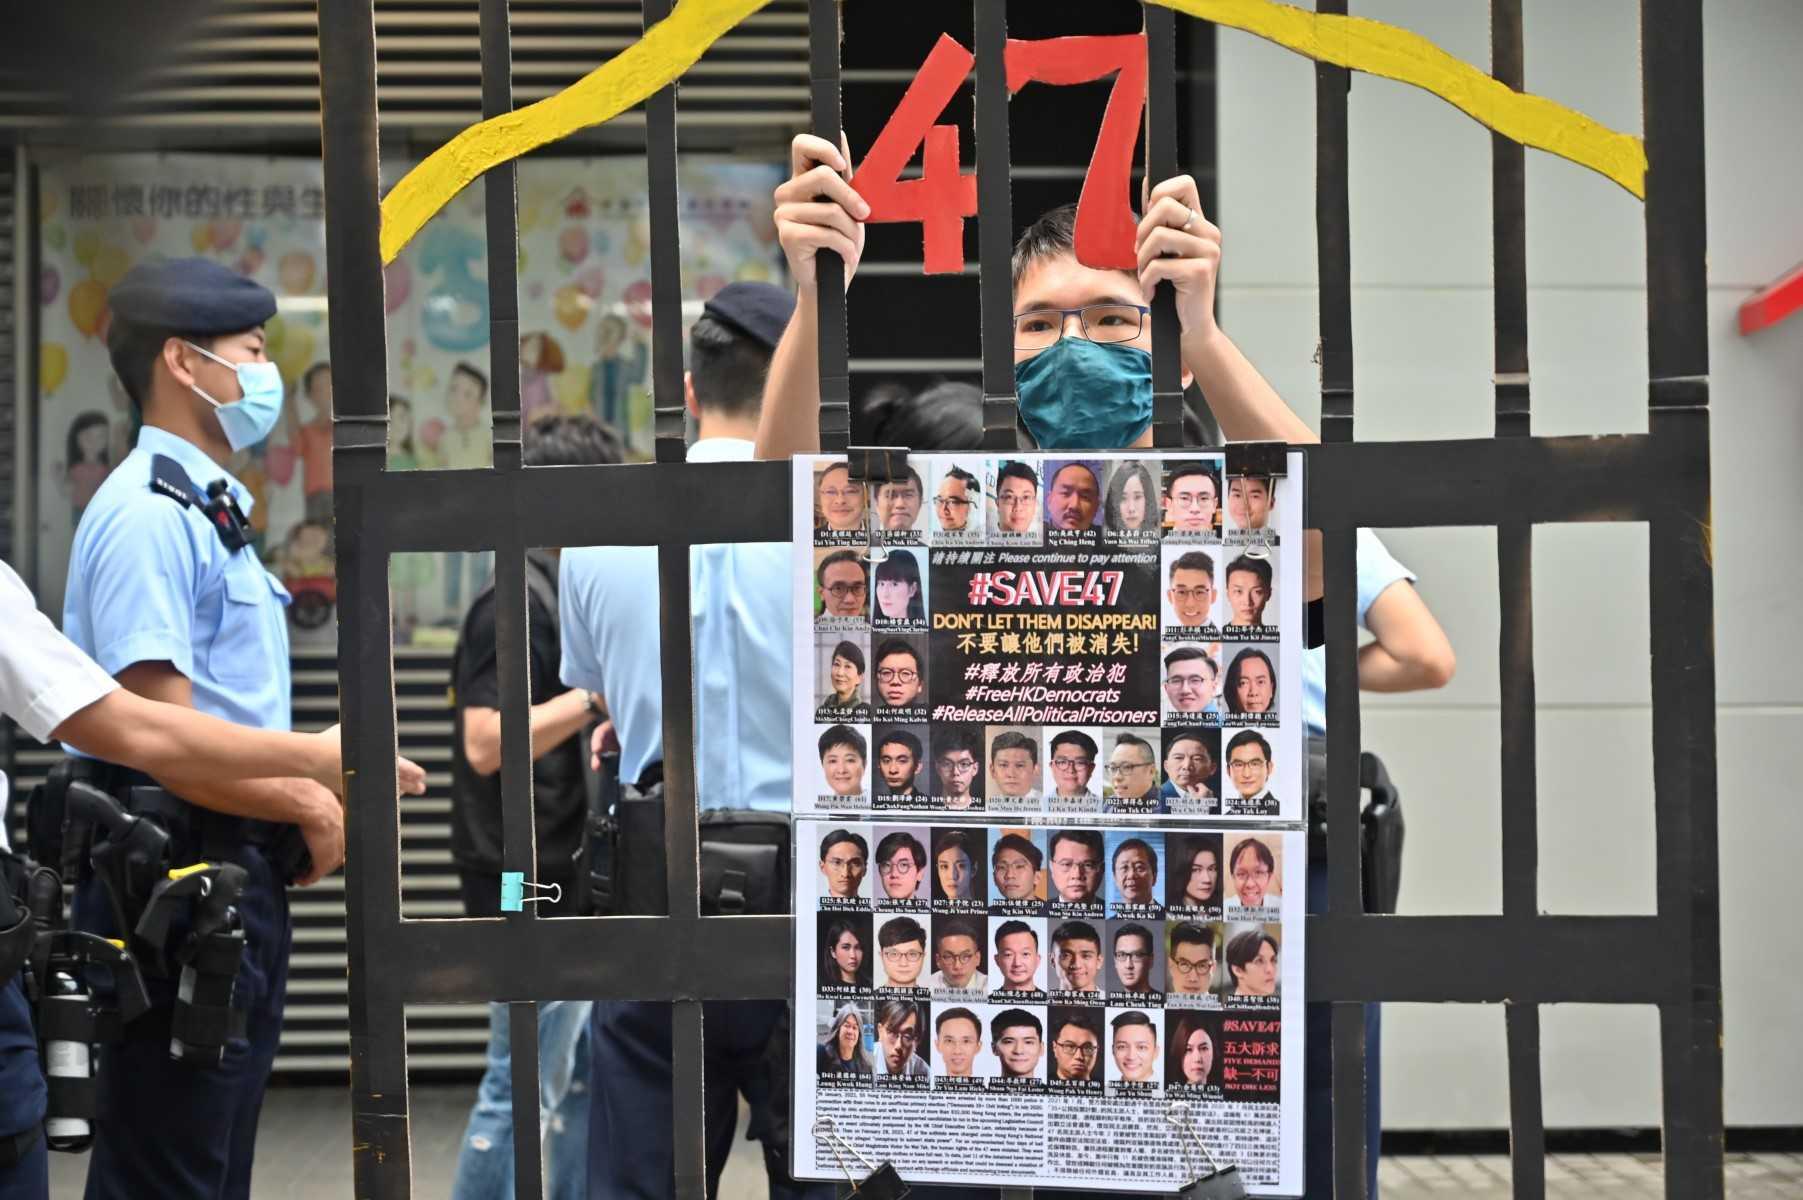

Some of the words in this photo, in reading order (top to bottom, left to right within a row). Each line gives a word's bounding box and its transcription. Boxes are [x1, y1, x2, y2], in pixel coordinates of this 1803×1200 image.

[849, 32, 1147, 274] 47
[998, 553, 1031, 564] Please
[1032, 553, 1076, 564] continue
[1078, 553, 1089, 564] to
[1090, 554, 1110, 567] pay
[1111, 553, 1157, 564] attention
[968, 571, 1124, 606] #SAVE47
[933, 614, 984, 630] DON'T
[988, 614, 1013, 630] LET
[1017, 614, 1061, 631] THEM
[957, 632, 1139, 656] 不要讓他們被消失!
[965, 662, 1127, 684] #釋放所有政治犯
[965, 686, 1121, 703] #FreeHKDemocrats
[932, 705, 1157, 723] #ReleaseAllPoliticalPrisoners
[1223, 1020, 1280, 1032] #SAVE47
[1224, 1041, 1279, 1056] 五大訴求
[1224, 1066, 1279, 1081] 缺一不可
